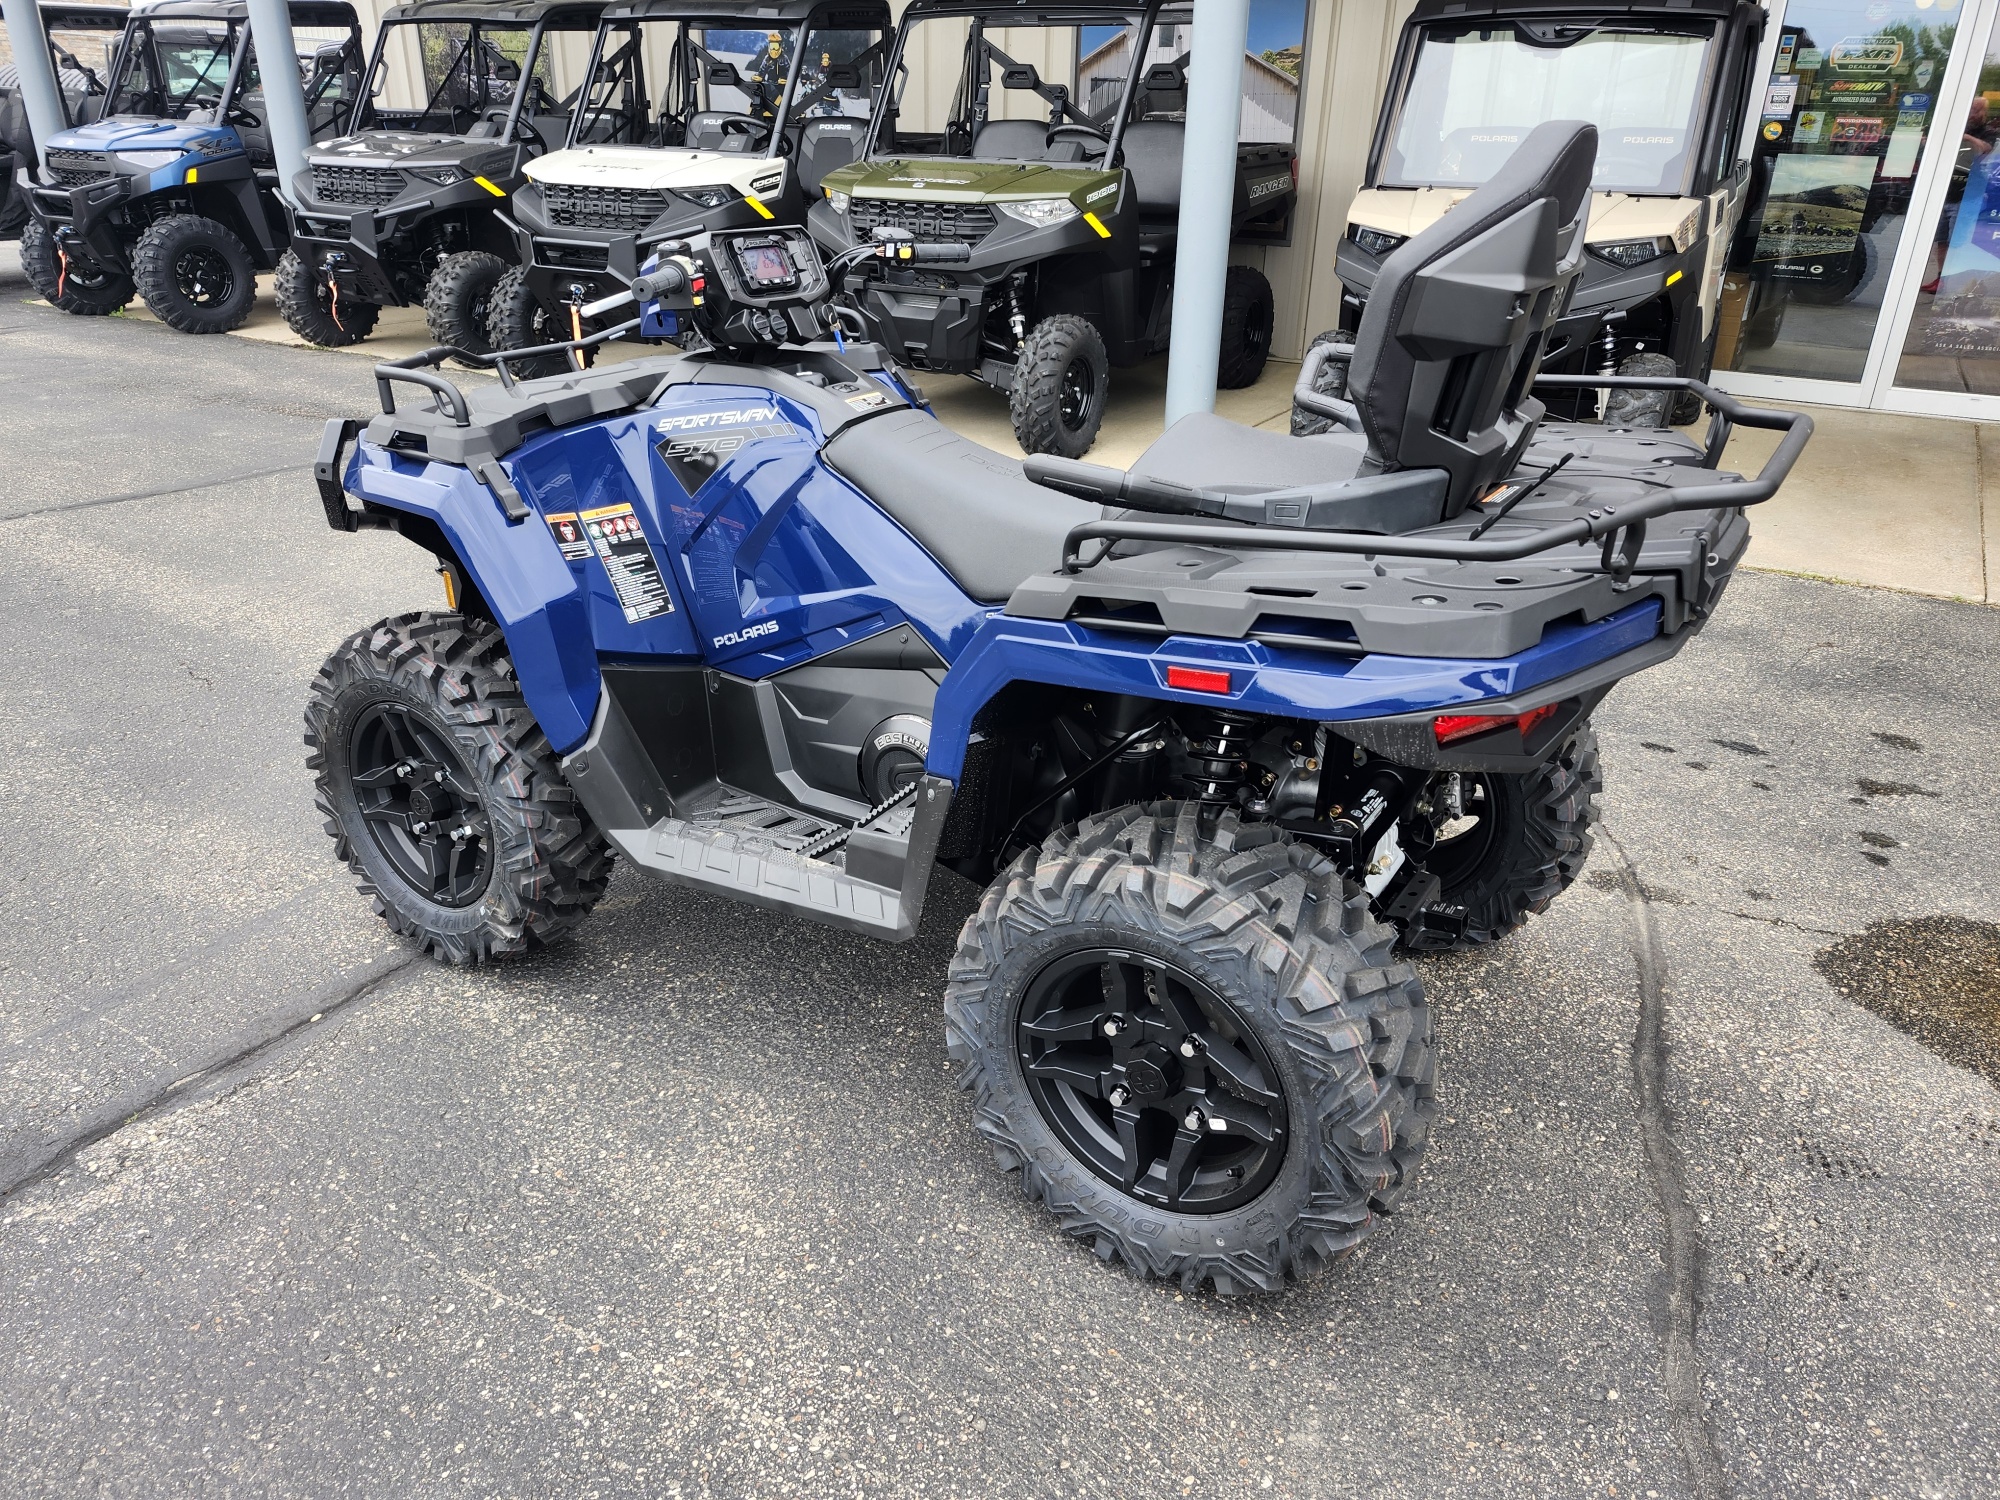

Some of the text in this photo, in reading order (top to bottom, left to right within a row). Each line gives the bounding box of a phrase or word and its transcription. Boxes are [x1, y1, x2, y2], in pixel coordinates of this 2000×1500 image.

[1837, 48, 1898, 60] FXR
[202, 146, 232, 157] 1000
[482, 159, 512, 171] 1000
[320, 178, 376, 193] POLARIS
[753, 175, 780, 188] 1000
[1250, 176, 1289, 198] RANGER
[1087, 183, 1118, 203] 1000
[556, 199, 632, 216] POLARIS
[656, 407, 779, 432] SPORTSMAN
[665, 436, 744, 457] 570
[713, 620, 779, 649] POLARIS
[877, 734, 900, 747] EBS
[903, 735, 928, 754] ENGIN
[1188, 961, 1255, 1013] GRIP
[1034, 1146, 1167, 1240] DURO
